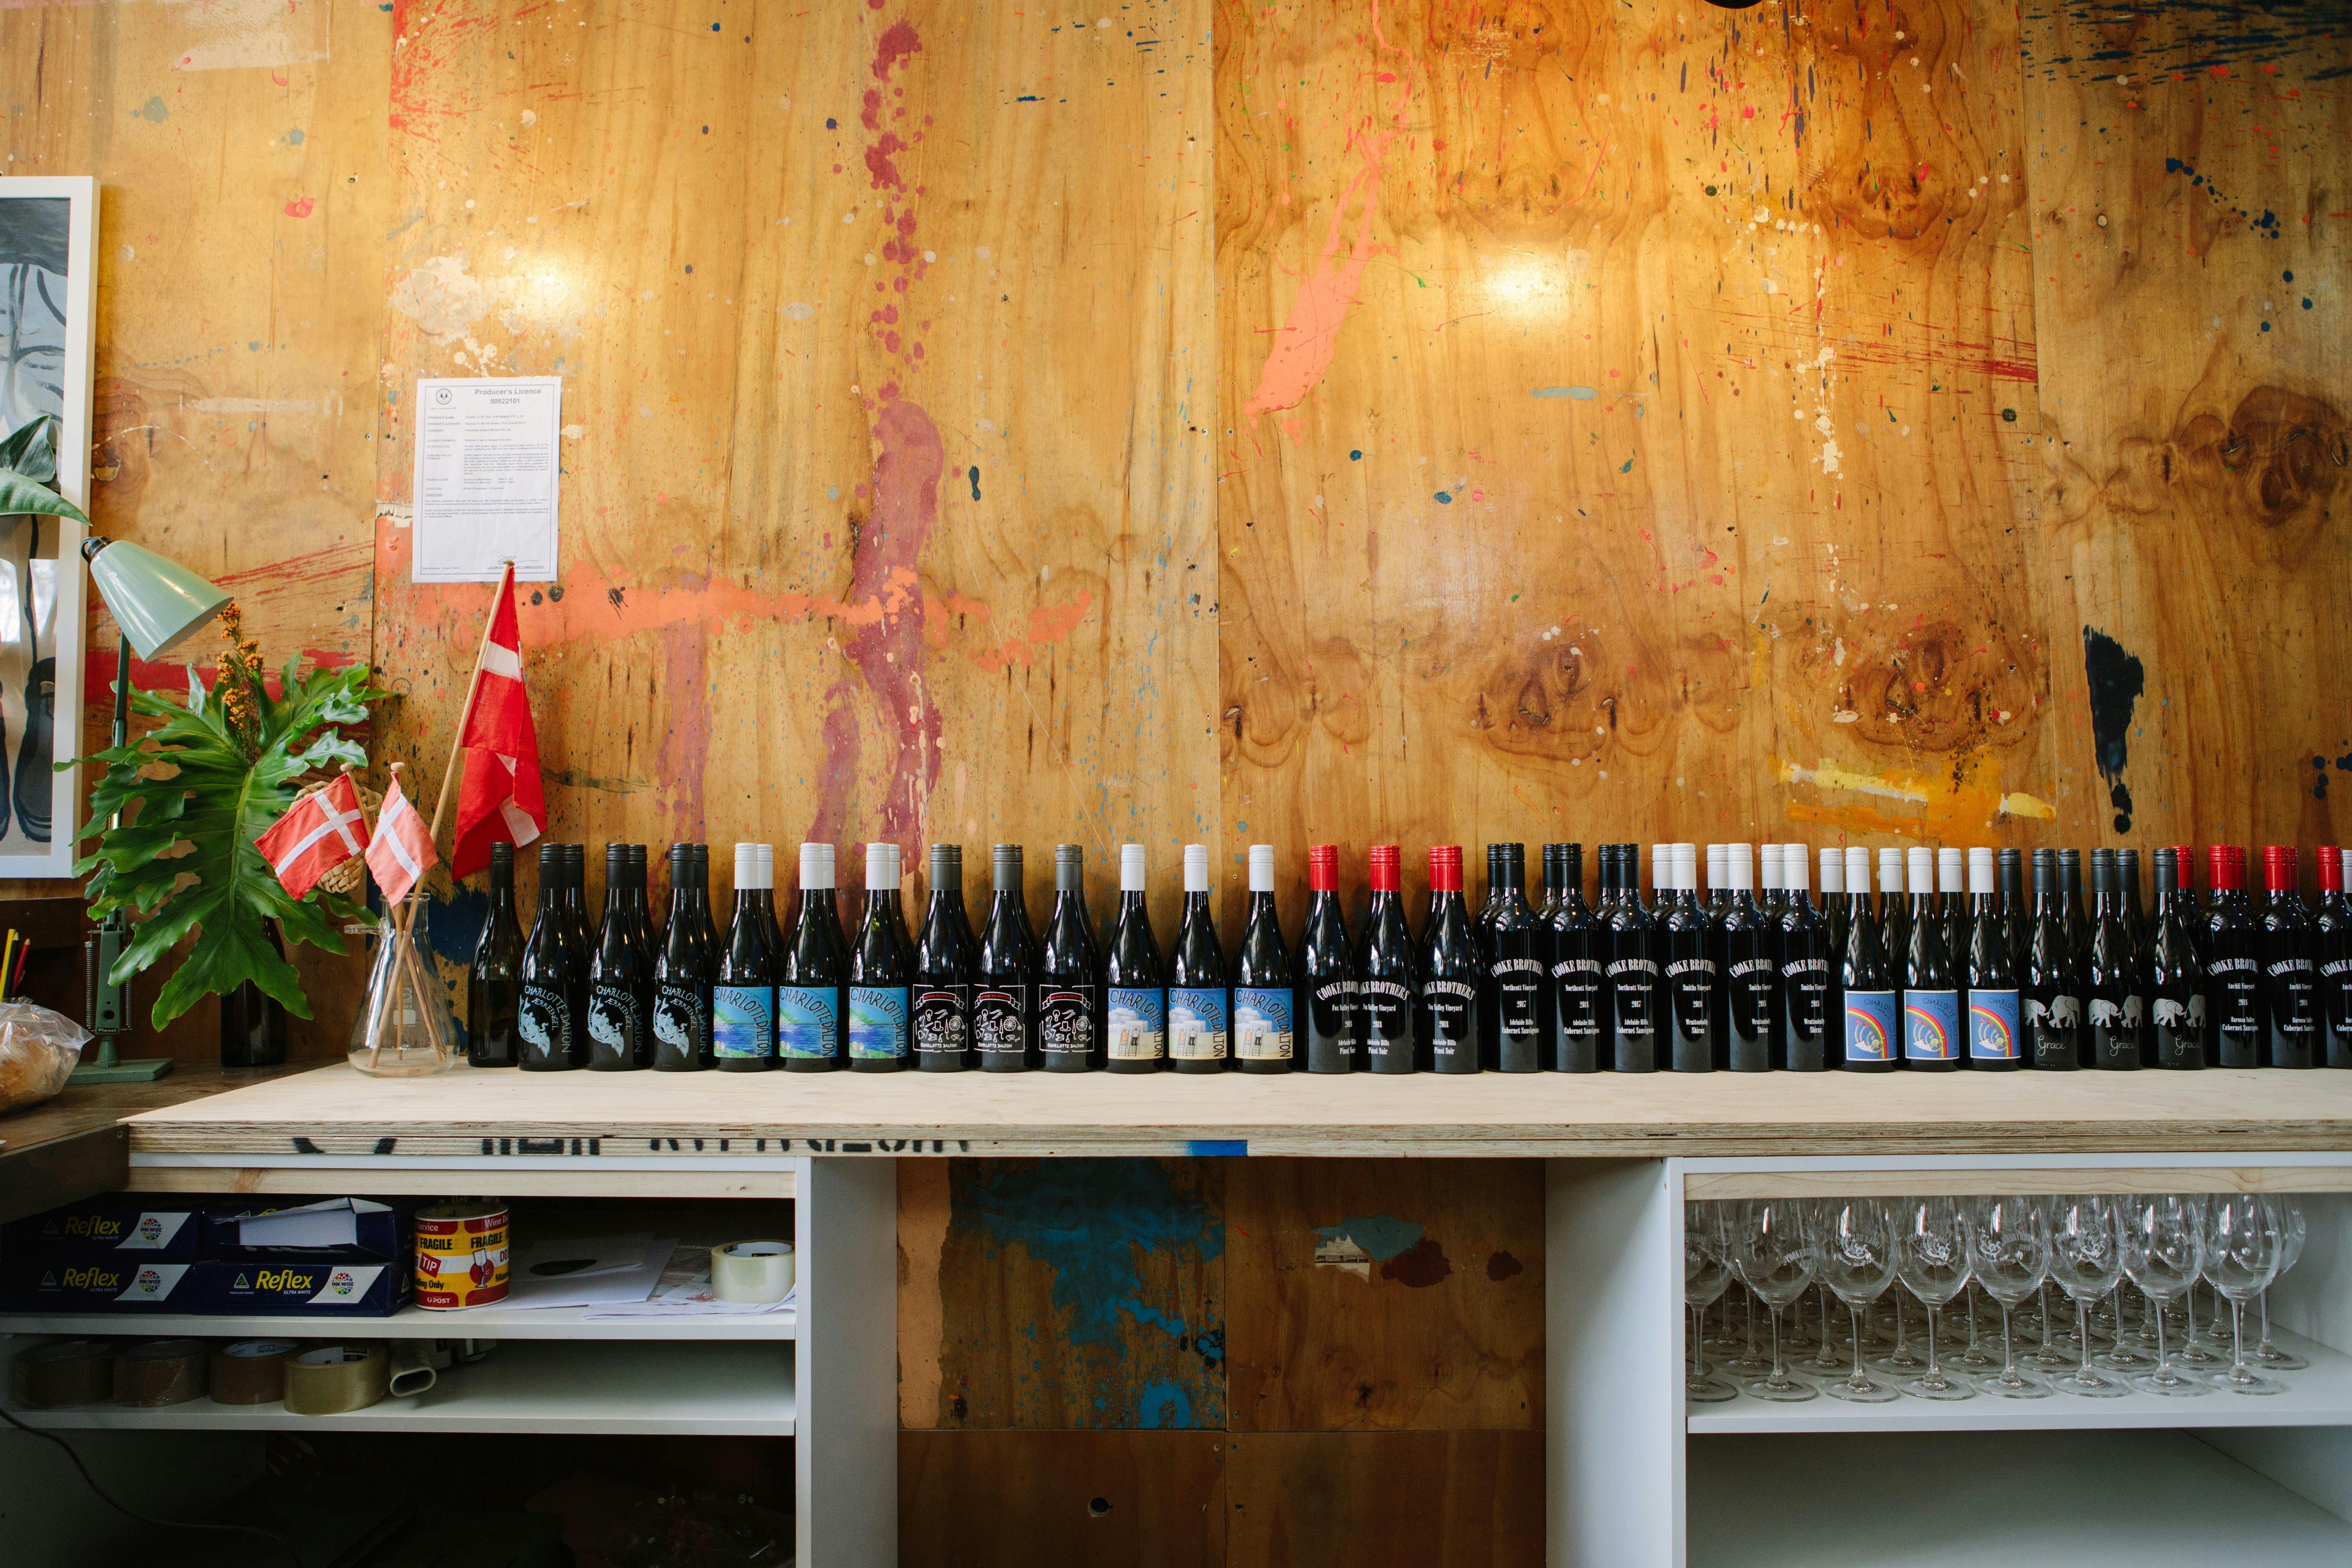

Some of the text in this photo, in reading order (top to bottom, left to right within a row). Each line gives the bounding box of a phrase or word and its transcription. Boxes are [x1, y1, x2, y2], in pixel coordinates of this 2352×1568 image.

[1491, 960, 1513, 978] COOKE
[1551, 960, 1575, 978] COOKE
[1605, 959, 1629, 978] COOKE
[1665, 960, 1689, 978] COOKE
[1729, 960, 1755, 978] COOKE
[1782, 960, 1807, 977] COOKE
[2207, 959, 2233, 976] COOKE
[2267, 959, 2295, 977] COOKE
[2320, 959, 2348, 977] COOKE
[1316, 982, 1342, 1001] COOKE
[1370, 981, 1410, 1001] BROTHERS
[1436, 981, 1476, 1001] BROTHERS
[1522, 984, 1537, 992] Vineyard
[1368, 1004, 1378, 1012] Valley
[1379, 1004, 1396, 1013] Vineyard
[1434, 1004, 1445, 1012] Valley
[1864, 998, 1894, 1019] CHARLOTTE
[1923, 997, 1955, 1019] CHARLOTTE
[525, 985, 572, 1052] CHARLOTTE DALTON
[597, 985, 643, 1052] CHARLOTTE DALTON
[662, 985, 708, 1052] CHARLOTTE DALTON
[714, 987, 767, 1022] CHARLOTTE
[755, 1019, 770, 1056] DALTON
[780, 987, 835, 1057] CHARLOTTE DALTON
[851, 988, 905, 1023] CHARLOTTE
[894, 1021, 906, 1057] DALTON
[1110, 989, 1161, 1024] CHARLOTTE
[1153, 1023, 1163, 1057] DALTON
[1170, 989, 1222, 1024] CHARLOTTE
[1212, 1023, 1224, 1057] DALTON
[1235, 989, 1289, 1024] CHARLOTTE
[1279, 1023, 1291, 1057] DALTON
[1439, 1020, 1449, 1029] 2018
[2038, 1035, 2065, 1056] Grace
[2110, 1035, 2135, 1056] Grace
[2175, 1035, 2201, 1055] Grace
[65, 1215, 122, 1237] Reflex
[417, 1221, 438, 1231] Service
[484, 1215, 501, 1228] Wine
[420, 1237, 453, 1250] FRAGILE
[471, 1231, 503, 1249] FRAGILE
[423, 1256, 437, 1272] TIP
[500, 1249, 508, 1263] DO
[63, 1266, 120, 1289] Reflex
[256, 1269, 313, 1292] Reflex
[429, 1280, 444, 1290] Only
